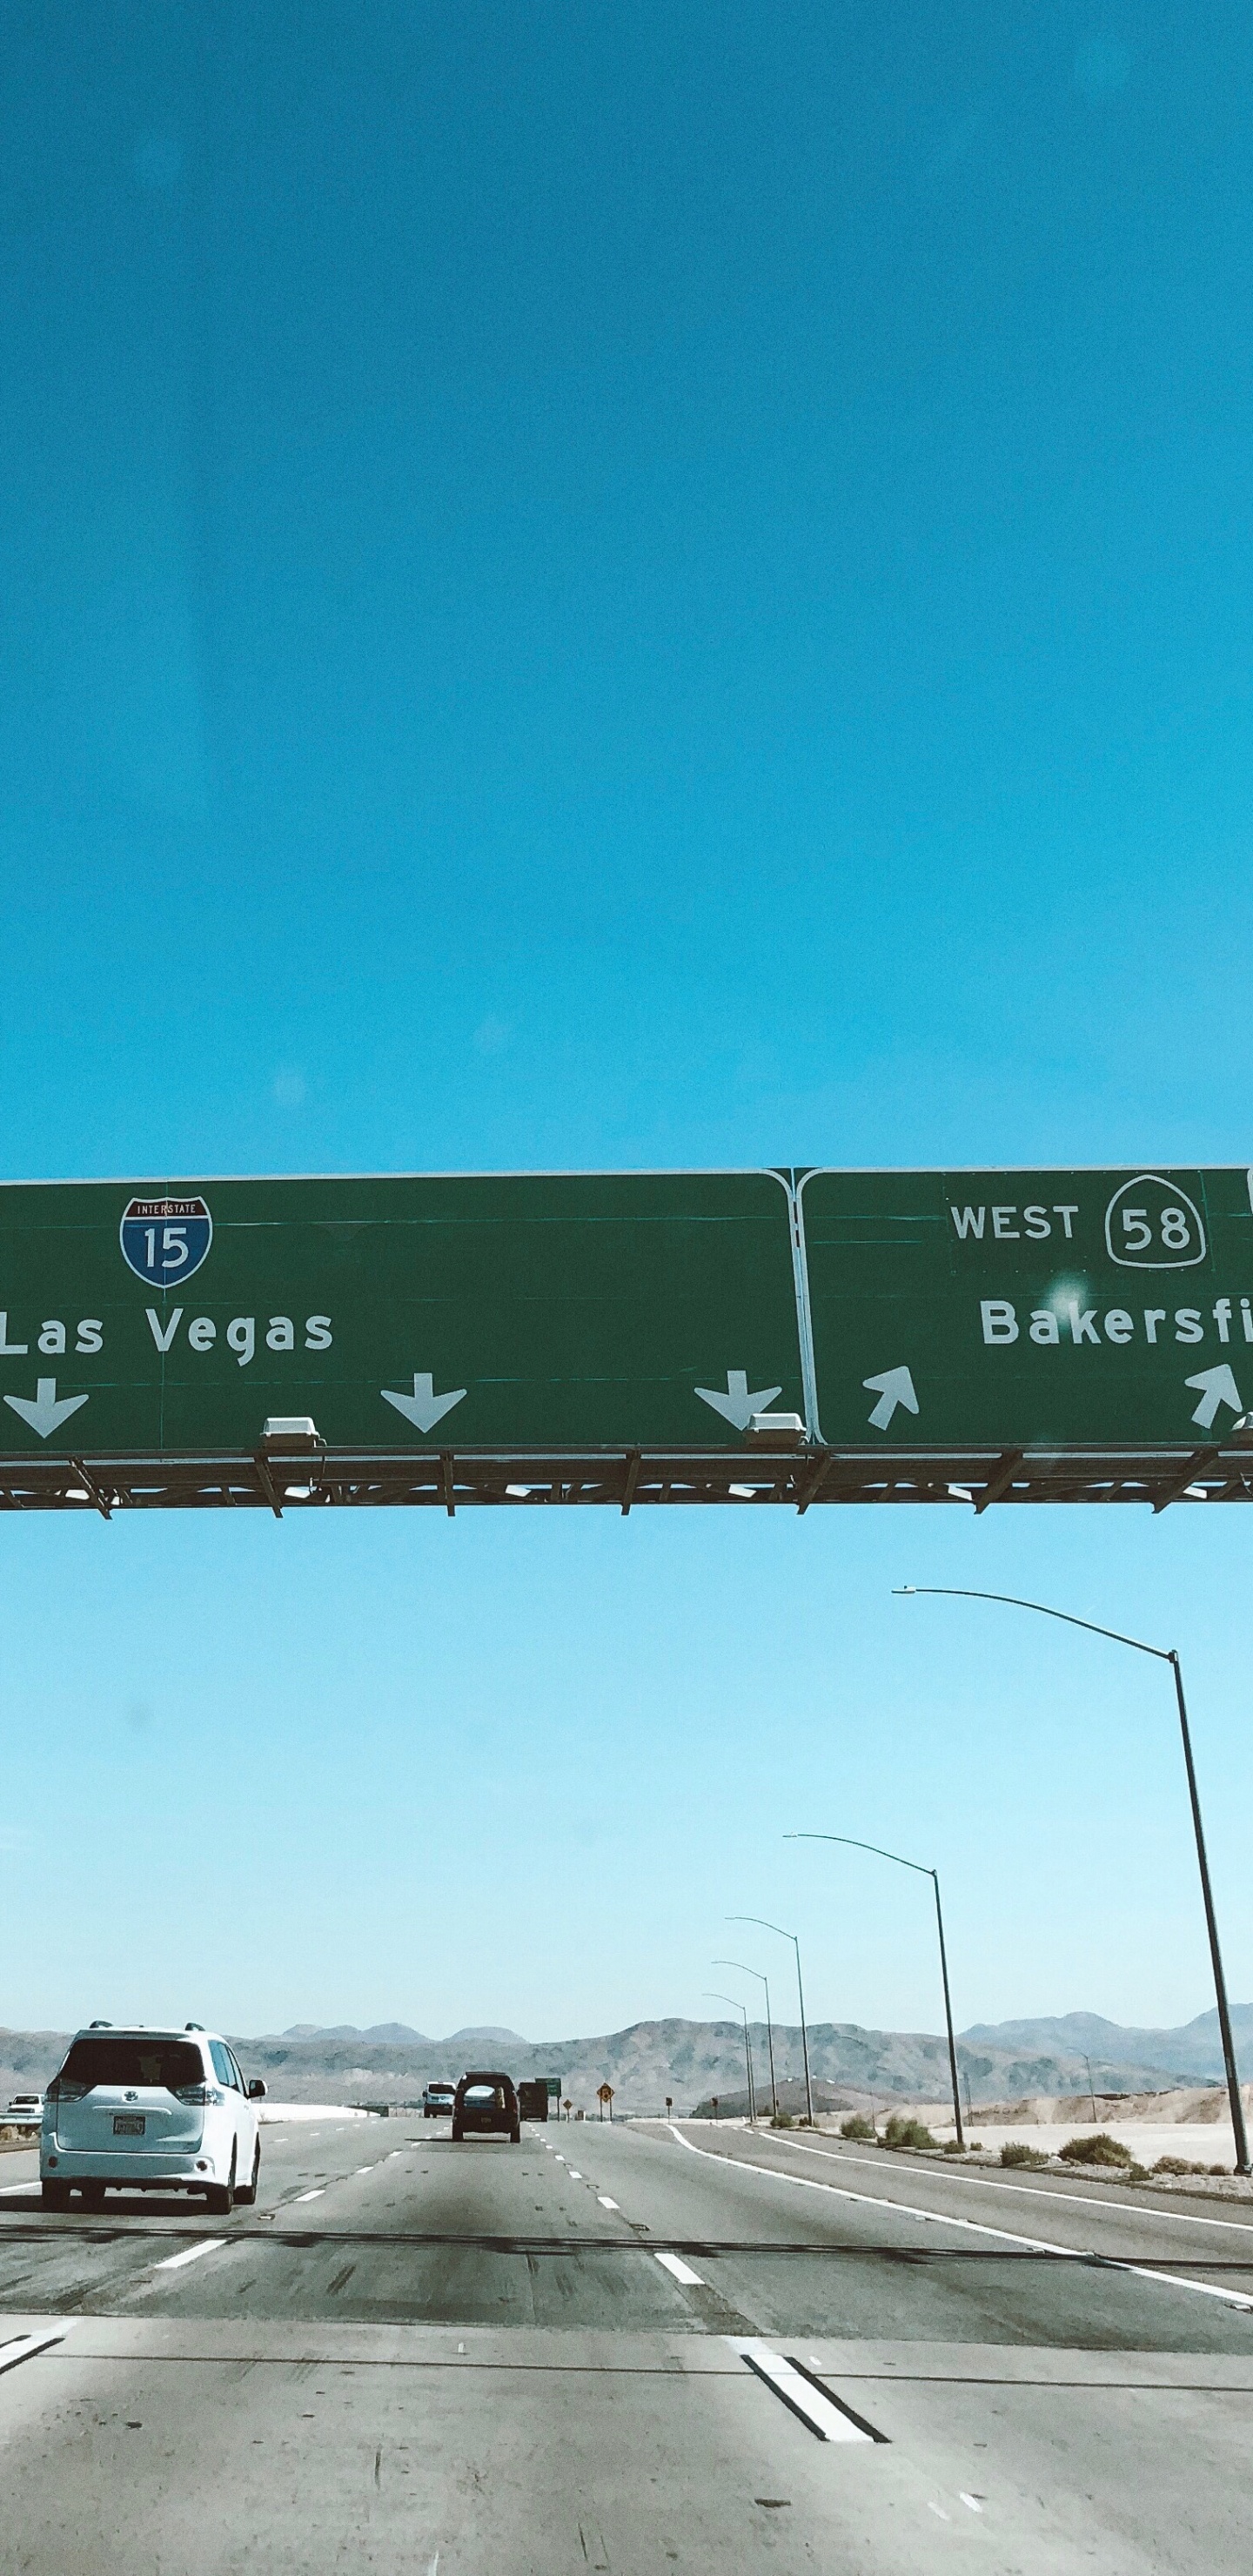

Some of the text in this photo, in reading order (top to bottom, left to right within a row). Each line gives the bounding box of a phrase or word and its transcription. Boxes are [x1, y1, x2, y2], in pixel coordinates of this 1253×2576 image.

[137, 1204, 196, 1215] INTERSTATE
[950, 1205, 1190, 1251] WEST 58
[144, 1227, 189, 1268] 15
[0, 1308, 332, 1366] Las Vegas
[980, 1298, 1253, 1345] Bakersfi
